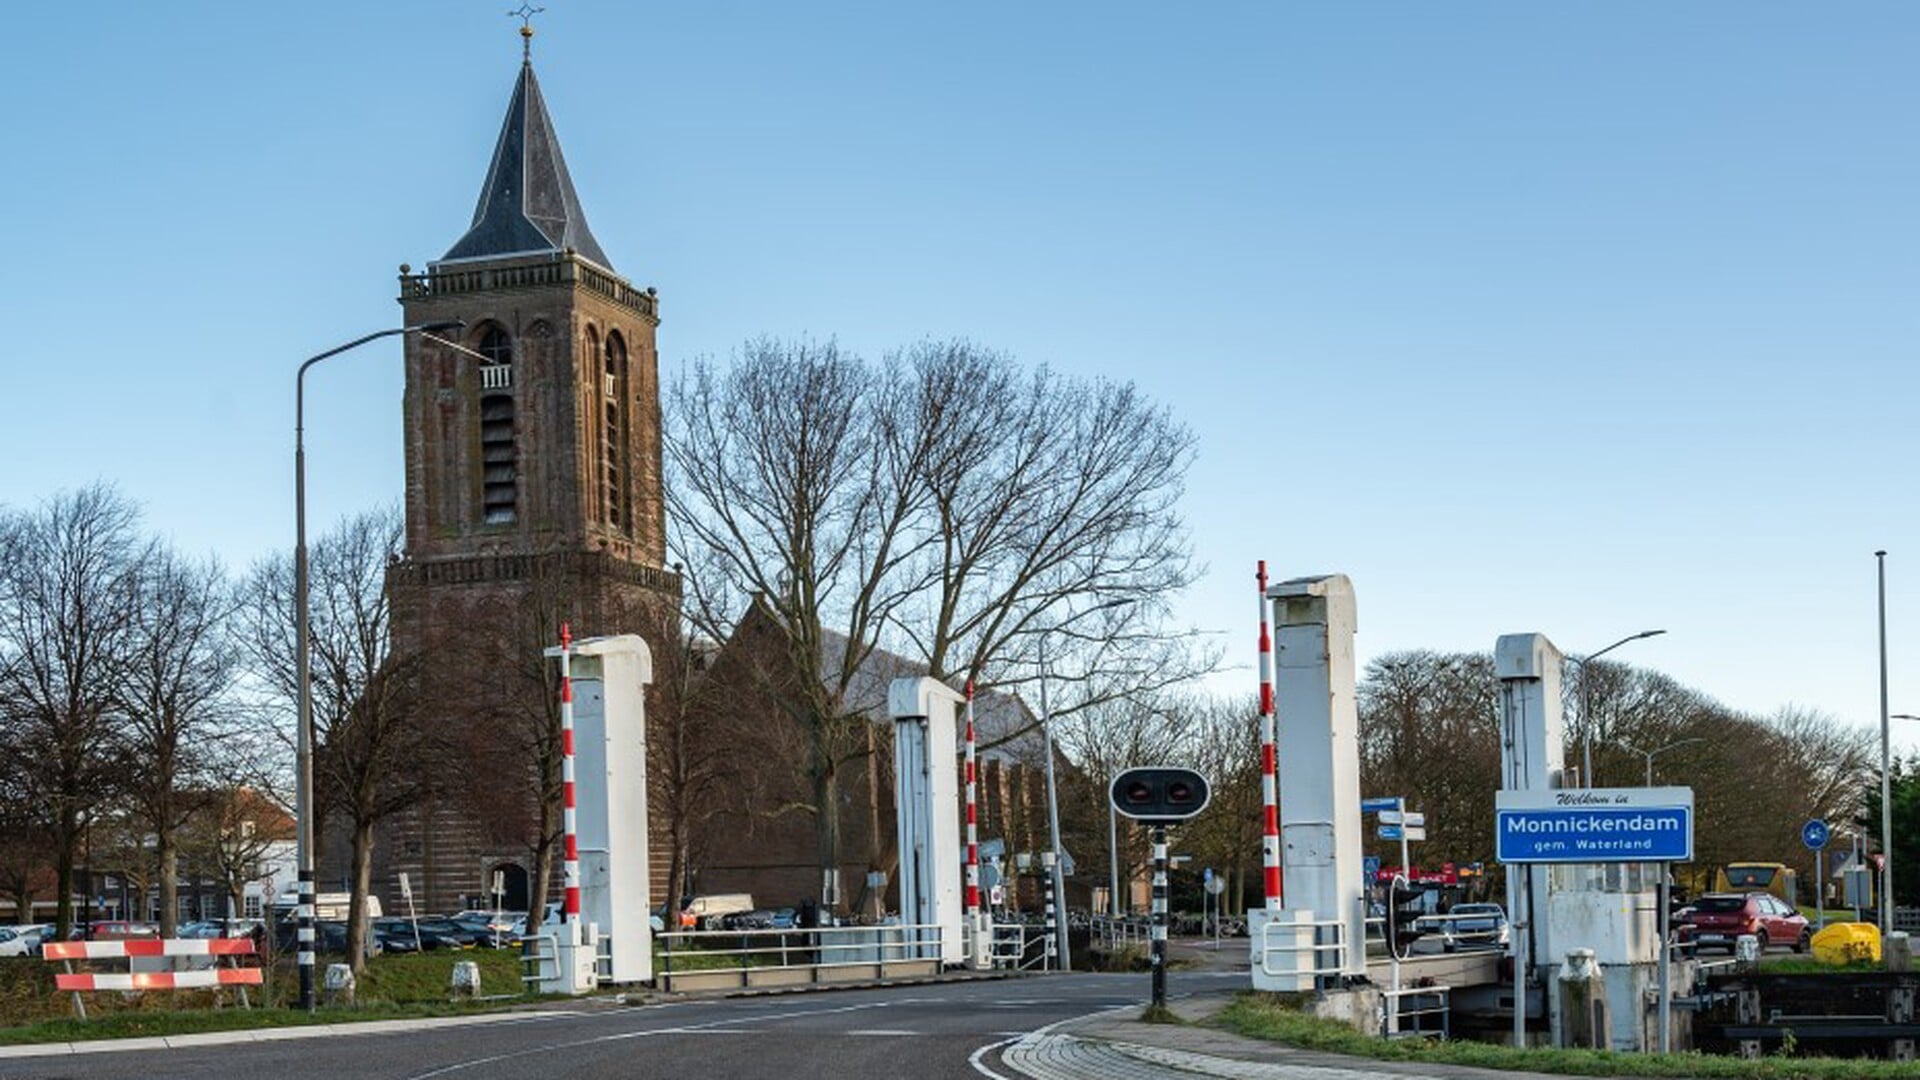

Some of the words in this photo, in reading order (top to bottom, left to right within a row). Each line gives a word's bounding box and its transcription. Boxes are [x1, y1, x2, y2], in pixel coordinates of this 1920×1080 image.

[1556, 792, 1609, 805] Welkom
[1615, 794, 1629, 803] in
[1507, 815, 1679, 833] Monnickendam
[1576, 839, 1652, 849] Waterland
